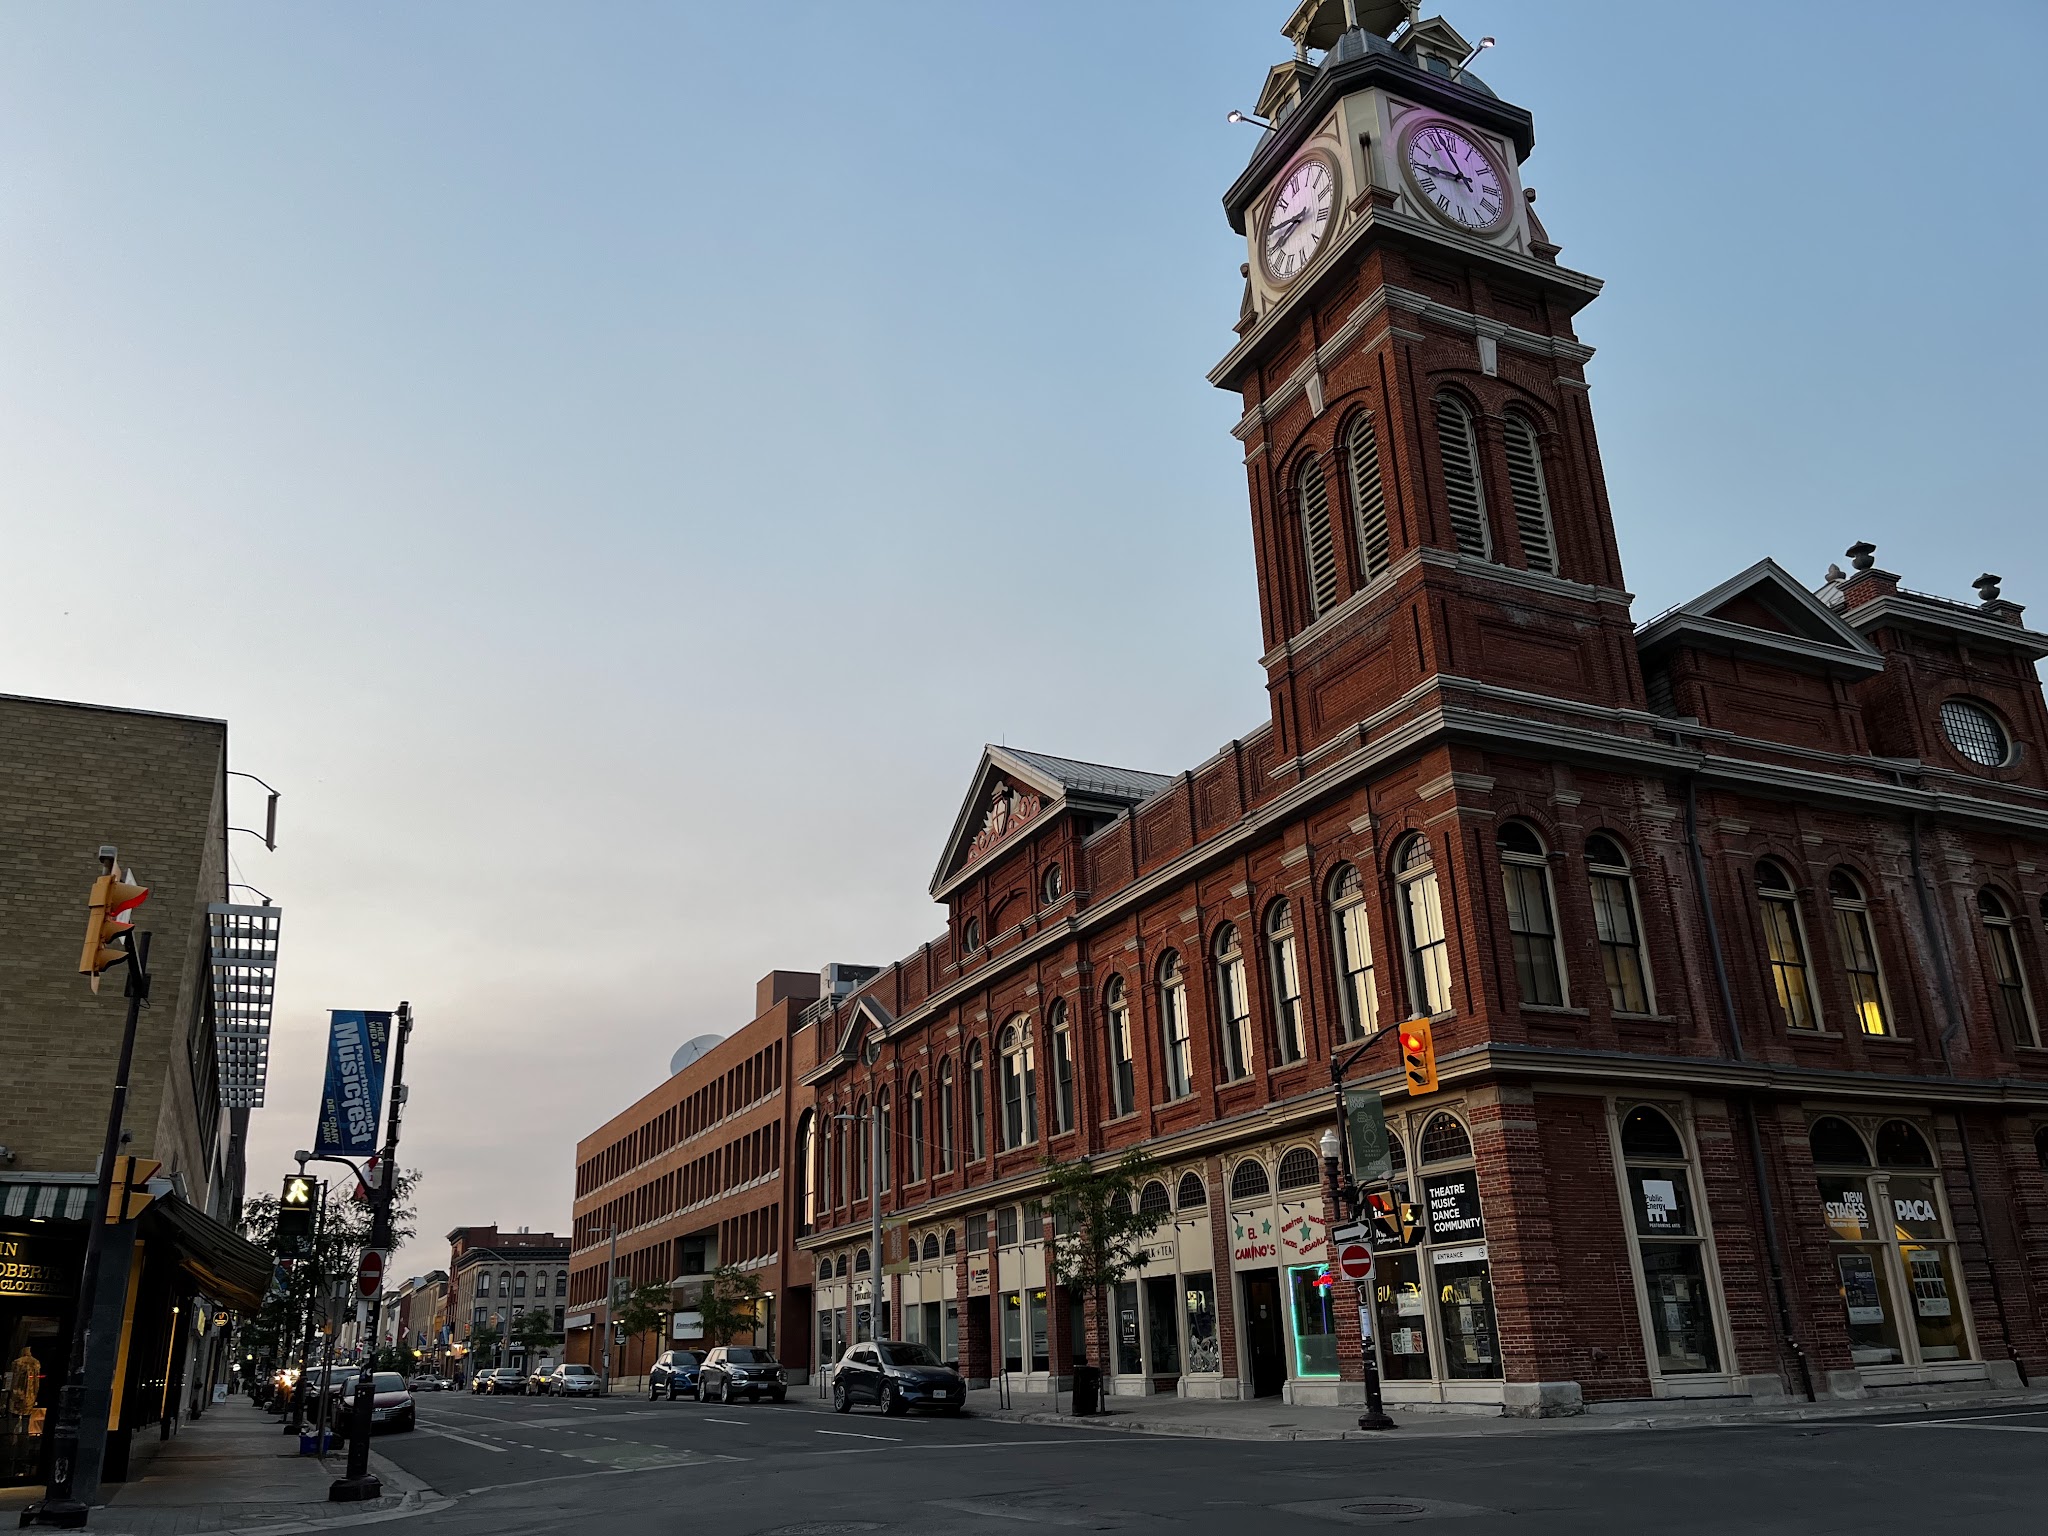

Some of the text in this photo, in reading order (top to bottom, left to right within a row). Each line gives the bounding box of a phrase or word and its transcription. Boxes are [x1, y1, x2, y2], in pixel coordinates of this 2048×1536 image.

[368, 1021, 378, 1040] WED
[375, 1021, 386, 1043] FREE
[372, 1048, 382, 1064] SAT
[333, 1021, 373, 1145] Musicfest
[355, 1044, 375, 1132] Peterborough
[326, 1098, 340, 1145] DEL CRARY
[322, 1121, 332, 1144] PARK
[1429, 1184, 1465, 1198] THEATRE
[1645, 1194, 1663, 1202] Public
[1843, 1191, 1863, 1203] new
[1431, 1197, 1456, 1210] MUSIC
[1647, 1202, 1666, 1211] Energy
[1826, 1202, 1867, 1219] STAGES
[1894, 1200, 1937, 1222] PACA
[1433, 1208, 1460, 1221] DANCE
[1434, 1217, 1481, 1233] COMMUNITY
[1247, 1228, 1258, 1240] EL
[1161, 1245, 1173, 1256] TEA
[1235, 1242, 1276, 1261] CAMINO'S
[1282, 1238, 1298, 1249] TACOS
[1438, 1252, 1463, 1260] ENTRANCE
